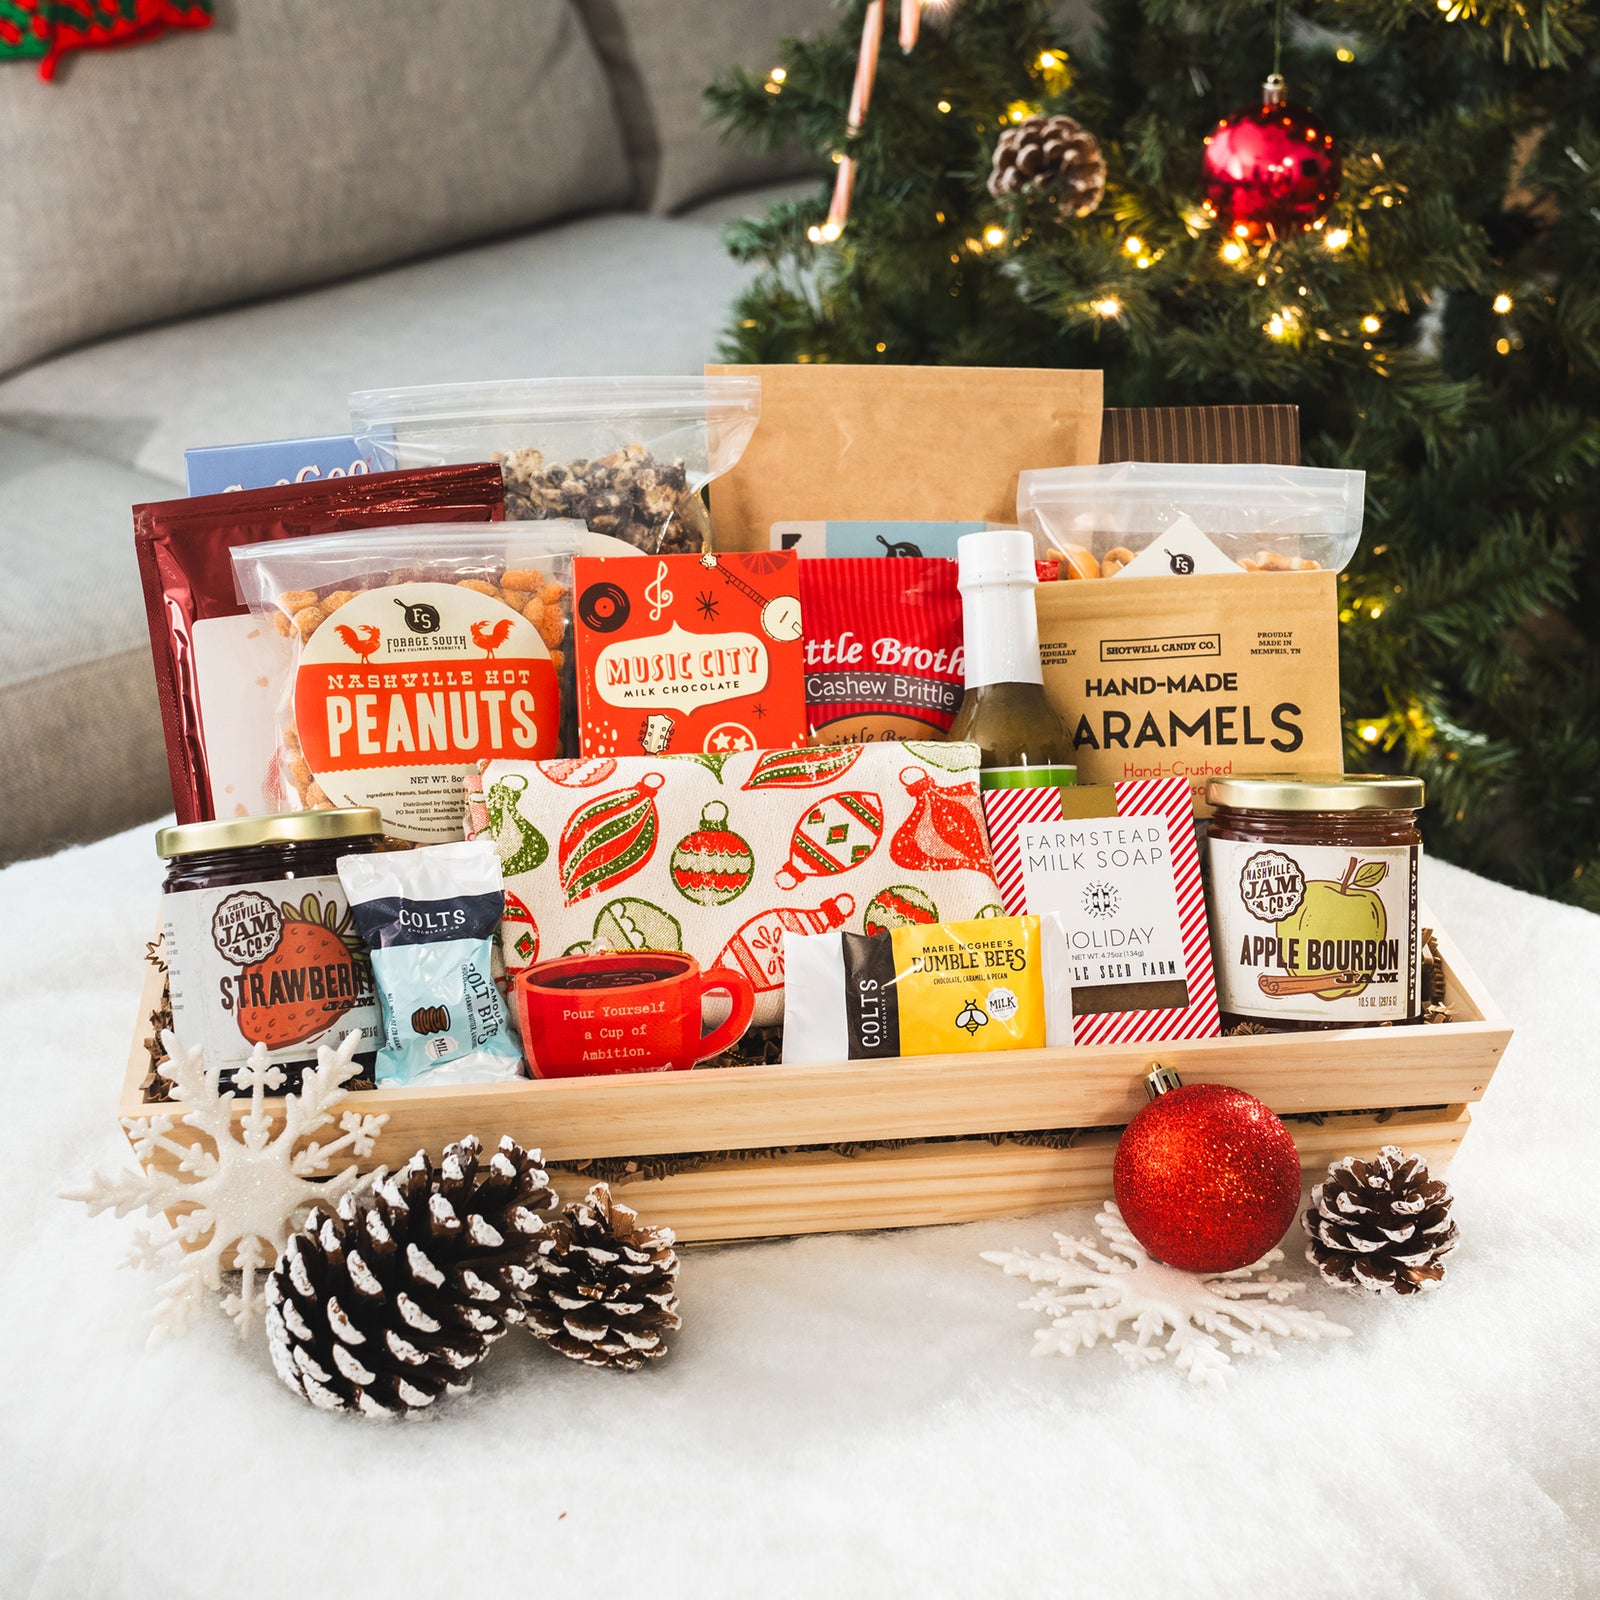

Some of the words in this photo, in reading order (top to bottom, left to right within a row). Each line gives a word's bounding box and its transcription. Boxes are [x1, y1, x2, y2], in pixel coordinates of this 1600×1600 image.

[387, 637, 429, 653] FORAGE
[432, 636, 467, 650] SOUTH
[803, 632, 863, 665] ttle
[1106, 644, 1160, 655] SHOTWELL
[1162, 642, 1196, 652] CANDY
[1198, 641, 1216, 650] CO.
[1250, 648, 1289, 656] MEMPHIS,
[605, 652, 692, 686] MUSIC
[699, 646, 759, 678] CITY
[328, 671, 473, 689] NASHVILLE
[485, 670, 530, 684] HOT
[1086, 672, 1238, 697] HAND-MADE
[624, 687, 655, 698] MILK
[662, 680, 740, 694] CHOCOLATE
[807, 676, 887, 697] Cashew
[894, 678, 954, 706] Brittle
[326, 690, 538, 757] PEANUTS
[1124, 760, 1232, 778] Hand-Crushed
[410, 776, 429, 784] NET
[432, 776, 449, 784] WT.
[1026, 828, 1160, 850] FARMSTEAD
[1029, 852, 1084, 872] MILK
[1096, 848, 1162, 868] SOAP
[1256, 860, 1271, 868] THE
[1247, 863, 1290, 880] NASHVILLE
[1245, 874, 1299, 900] JAM
[219, 902, 266, 926] NASHVILLE
[227, 902, 244, 912] THE
[399, 910, 466, 928] COLTS
[219, 912, 277, 947] JAM
[922, 944, 954, 954] MARIE
[959, 940, 1013, 950] MCGHEE'S
[1123, 950, 1144, 958] (134g)
[1240, 934, 1300, 969] APPLE
[1307, 938, 1399, 971] BOURBON
[984, 948, 1026, 971] BEES
[934, 976, 962, 984] CHOCOLATE,
[963, 974, 986, 982] CARAMEL,
[1100, 964, 1131, 979] SEED
[1142, 961, 1176, 975] FARM
[1336, 972, 1398, 983] JAM
[322, 996, 375, 1012] JAM
[563, 1010, 594, 1020] Pour
[602, 1001, 665, 1017] Yourself
[990, 996, 1016, 1009] MILK
[860, 979, 880, 1048] COLTS
[600, 1028, 623, 1039] Cup
[632, 1024, 647, 1035] of
[434, 1037, 448, 1057] MIL
[582, 1048, 651, 1060] Ambition.
